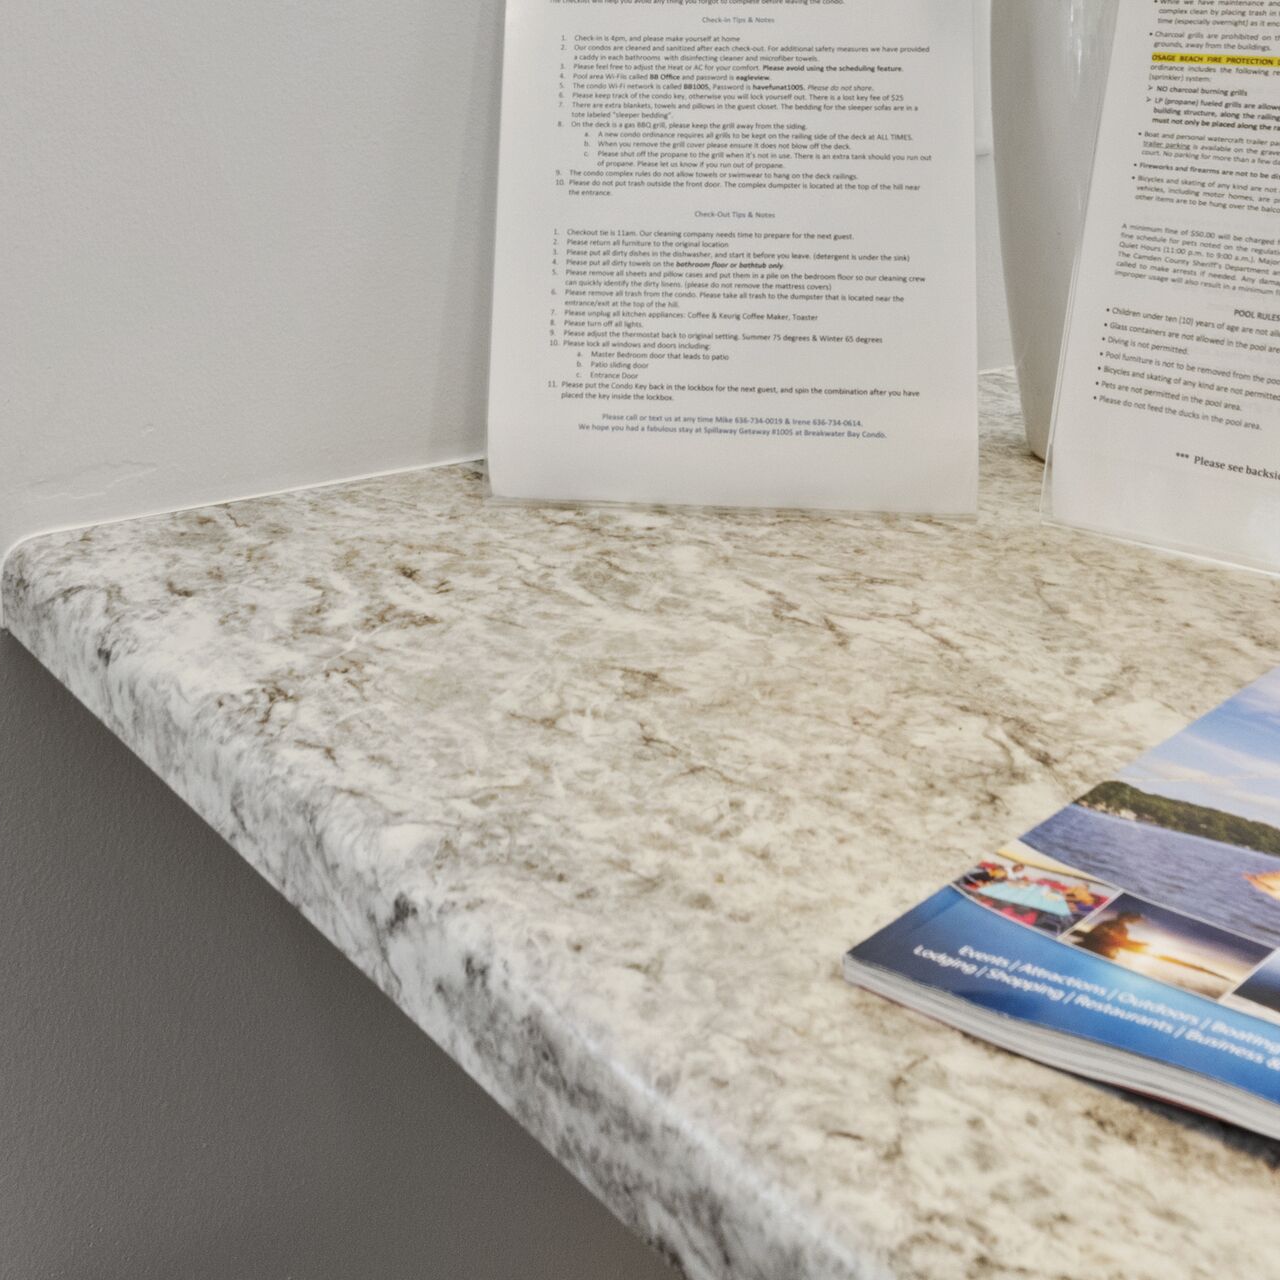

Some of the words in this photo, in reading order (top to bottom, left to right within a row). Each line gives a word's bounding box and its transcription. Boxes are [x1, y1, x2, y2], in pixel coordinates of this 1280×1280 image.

[732, 16, 746, 24] Tips
[1151, 53, 1176, 62] OSAGE
[1178, 54, 1203, 62] BEACH
[1225, 56, 1274, 65] PROTECTION
[1168, 86, 1199, 94] charcoal
[1199, 87, 1229, 96] burning
[1229, 88, 1247, 97] grills
[1139, 161, 1173, 170] Fireworks
[1189, 165, 1220, 174] firearms
[1259, 171, 1269, 179] be
[693, 210, 730, 218] Check-Out
[731, 210, 746, 218] Tips
[1233, 308, 1254, 319] POOL
[1256, 311, 1280, 322] RULES
[602, 319, 613, 327] off
[1107, 335, 1129, 347] Diving
[1129, 339, 1136, 347] is
[1136, 341, 1150, 349] not
[590, 350, 615, 358] Master
[616, 350, 648, 358] Bedroom
[648, 351, 665, 359] door
[682, 352, 701, 360] leads
[710, 353, 729, 361] patio
[590, 360, 608, 368] Patio
[609, 361, 631, 370] sliding
[631, 361, 648, 369] door
[589, 371, 620, 379] Entrance
[621, 371, 638, 379] Door
[591, 423, 609, 431] hope
[646, 424, 677, 432] fabulous
[678, 426, 693, 434] stay
[703, 426, 737, 435] Spillaway
[738, 427, 770, 436] Getaway
[770, 428, 793, 436] #1005
[803, 429, 845, 437] Breakwater
[846, 430, 860, 439] Bay
[1193, 455, 1226, 469] Please
[1226, 463, 1244, 473] see
[958, 945, 1010, 968] Events
[1018, 963, 1108, 997] Attractions
[1118, 991, 1200, 1026] Outdoors
[913, 945, 979, 976] Lodging
[985, 968, 1066, 1002] Shopping
[1073, 993, 1174, 1034] Restaurants
[1184, 1028, 1265, 1064] Business
